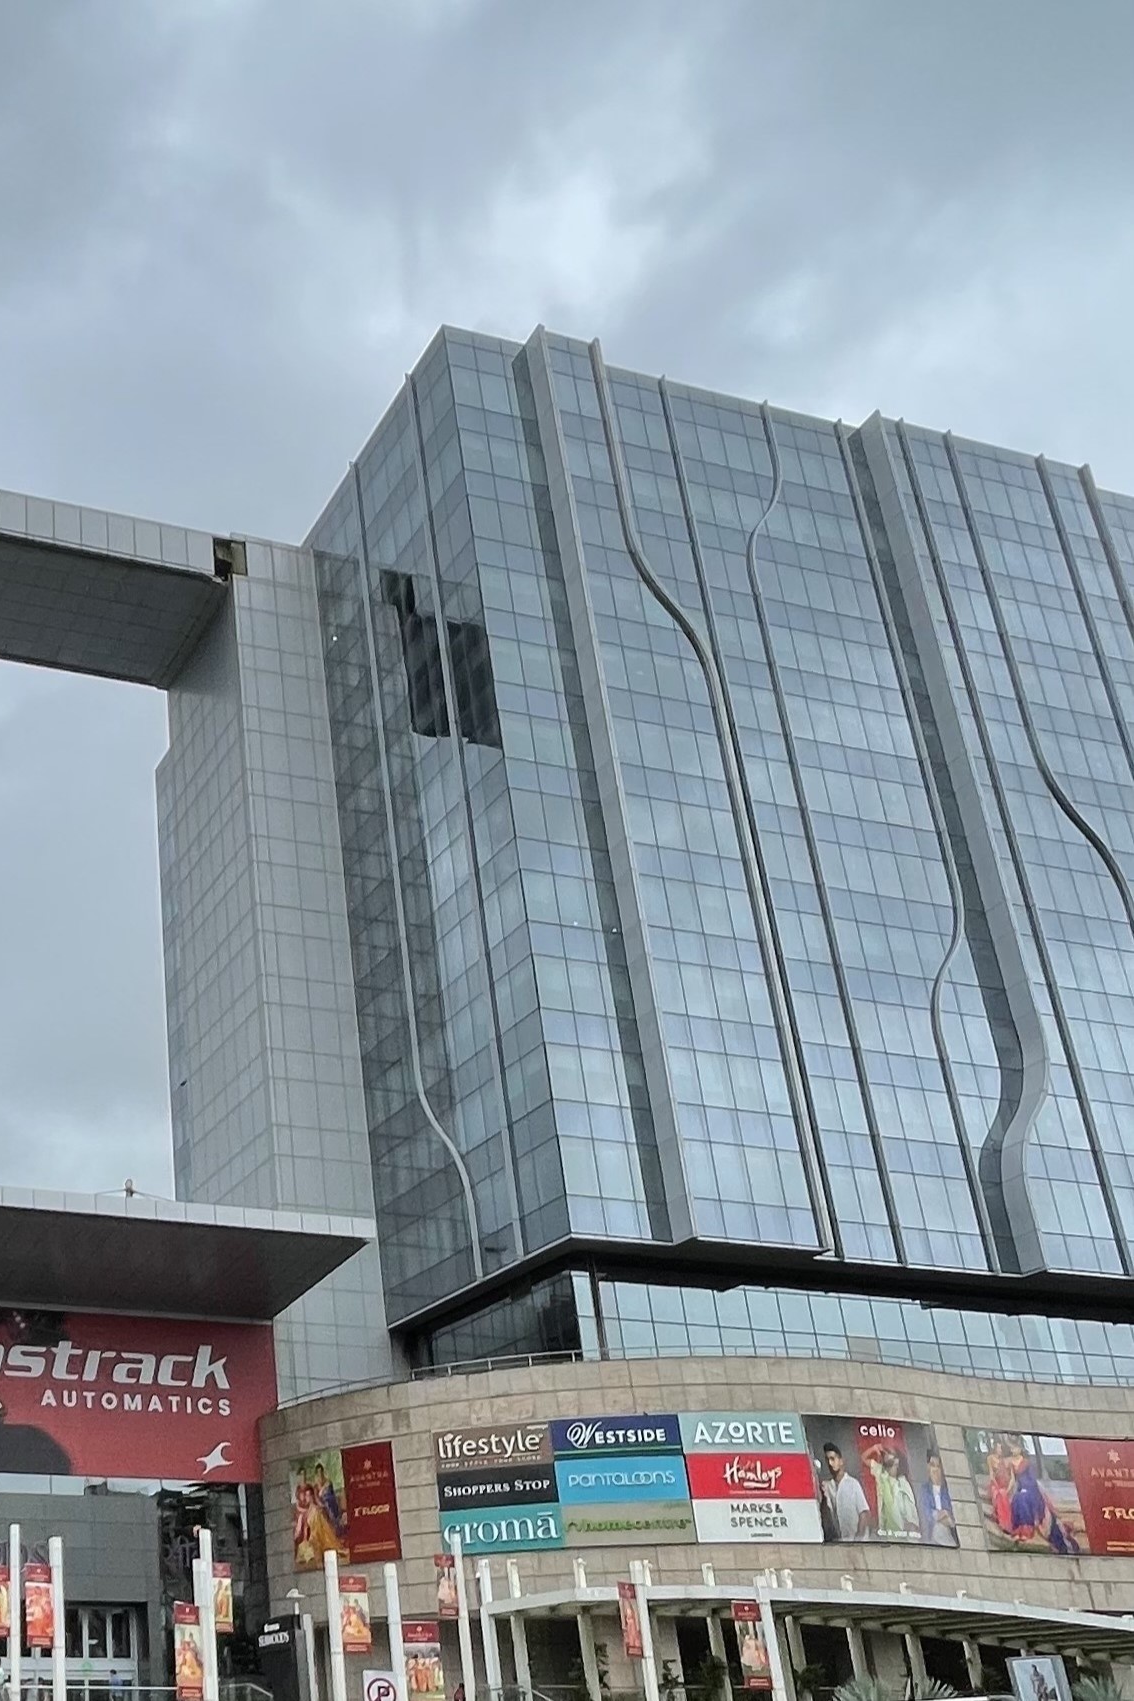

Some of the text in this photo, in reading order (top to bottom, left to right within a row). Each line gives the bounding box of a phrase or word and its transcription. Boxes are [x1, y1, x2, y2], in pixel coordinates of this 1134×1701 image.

[41, 1389, 231, 1416] AUTOMATICS
[567, 1422, 666, 1448] WESTSIDE
[694, 1422, 796, 1444] AZORTE
[860, 1424, 895, 1438] celio
[438, 1428, 541, 1459] lifestyle
[724, 1456, 782, 1489] Hamleys
[514, 1479, 550, 1492] STOP
[730, 1503, 783, 1514] MARKS &
[730, 1517, 788, 1528] SPENCER
